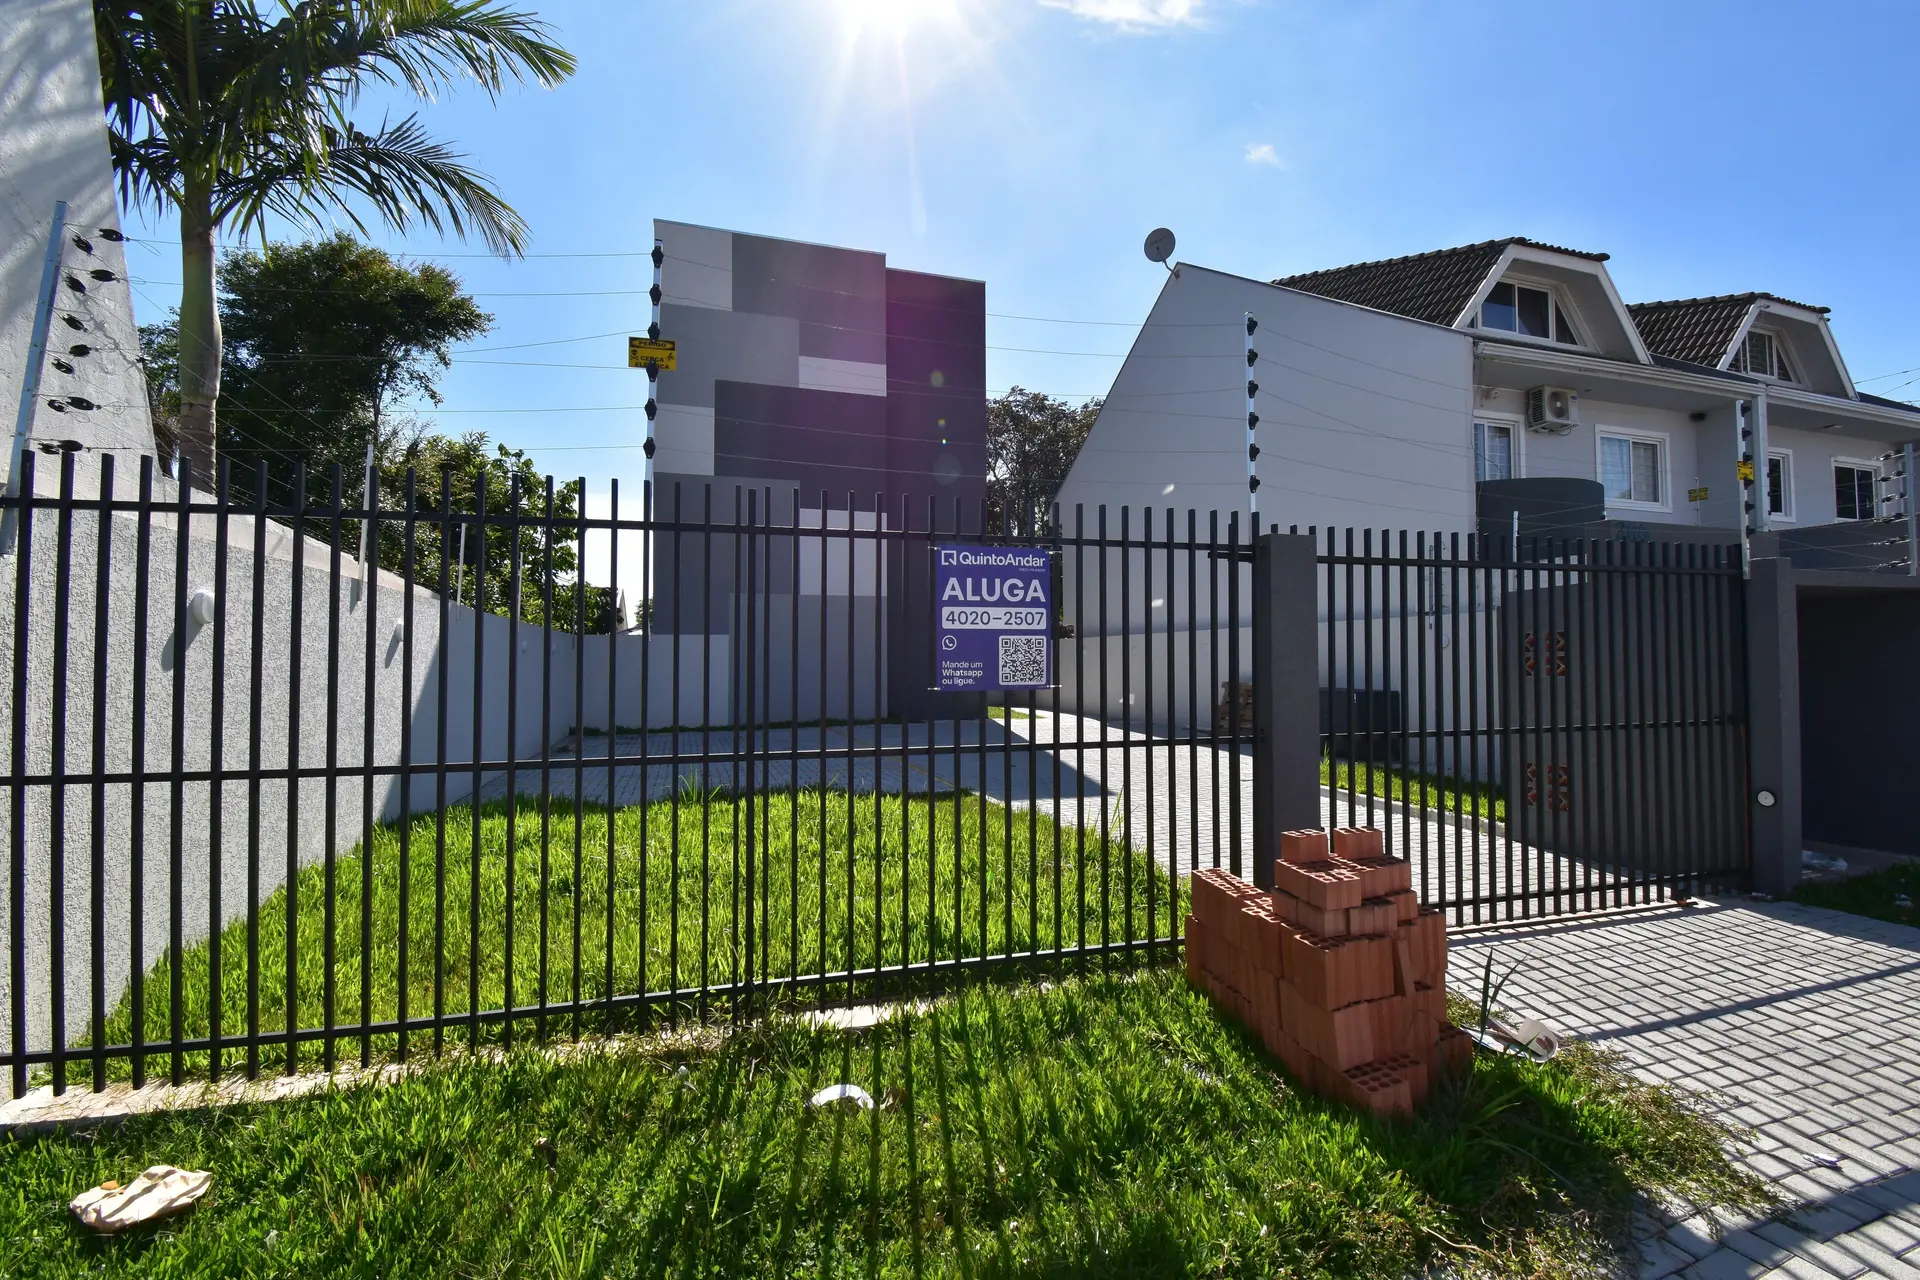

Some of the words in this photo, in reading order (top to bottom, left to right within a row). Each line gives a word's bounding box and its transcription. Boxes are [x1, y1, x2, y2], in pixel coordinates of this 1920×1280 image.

[959, 551, 1046, 567] QuintoAndar
[941, 577, 1046, 602] ALUGA
[945, 610, 1045, 626] 4020-2507
[942, 661, 969, 669] Mande
[970, 661, 983, 669] um
[942, 669, 983, 678] Whatsapp
[942, 678, 953, 686] ou
[953, 677, 976, 686] ligue.
